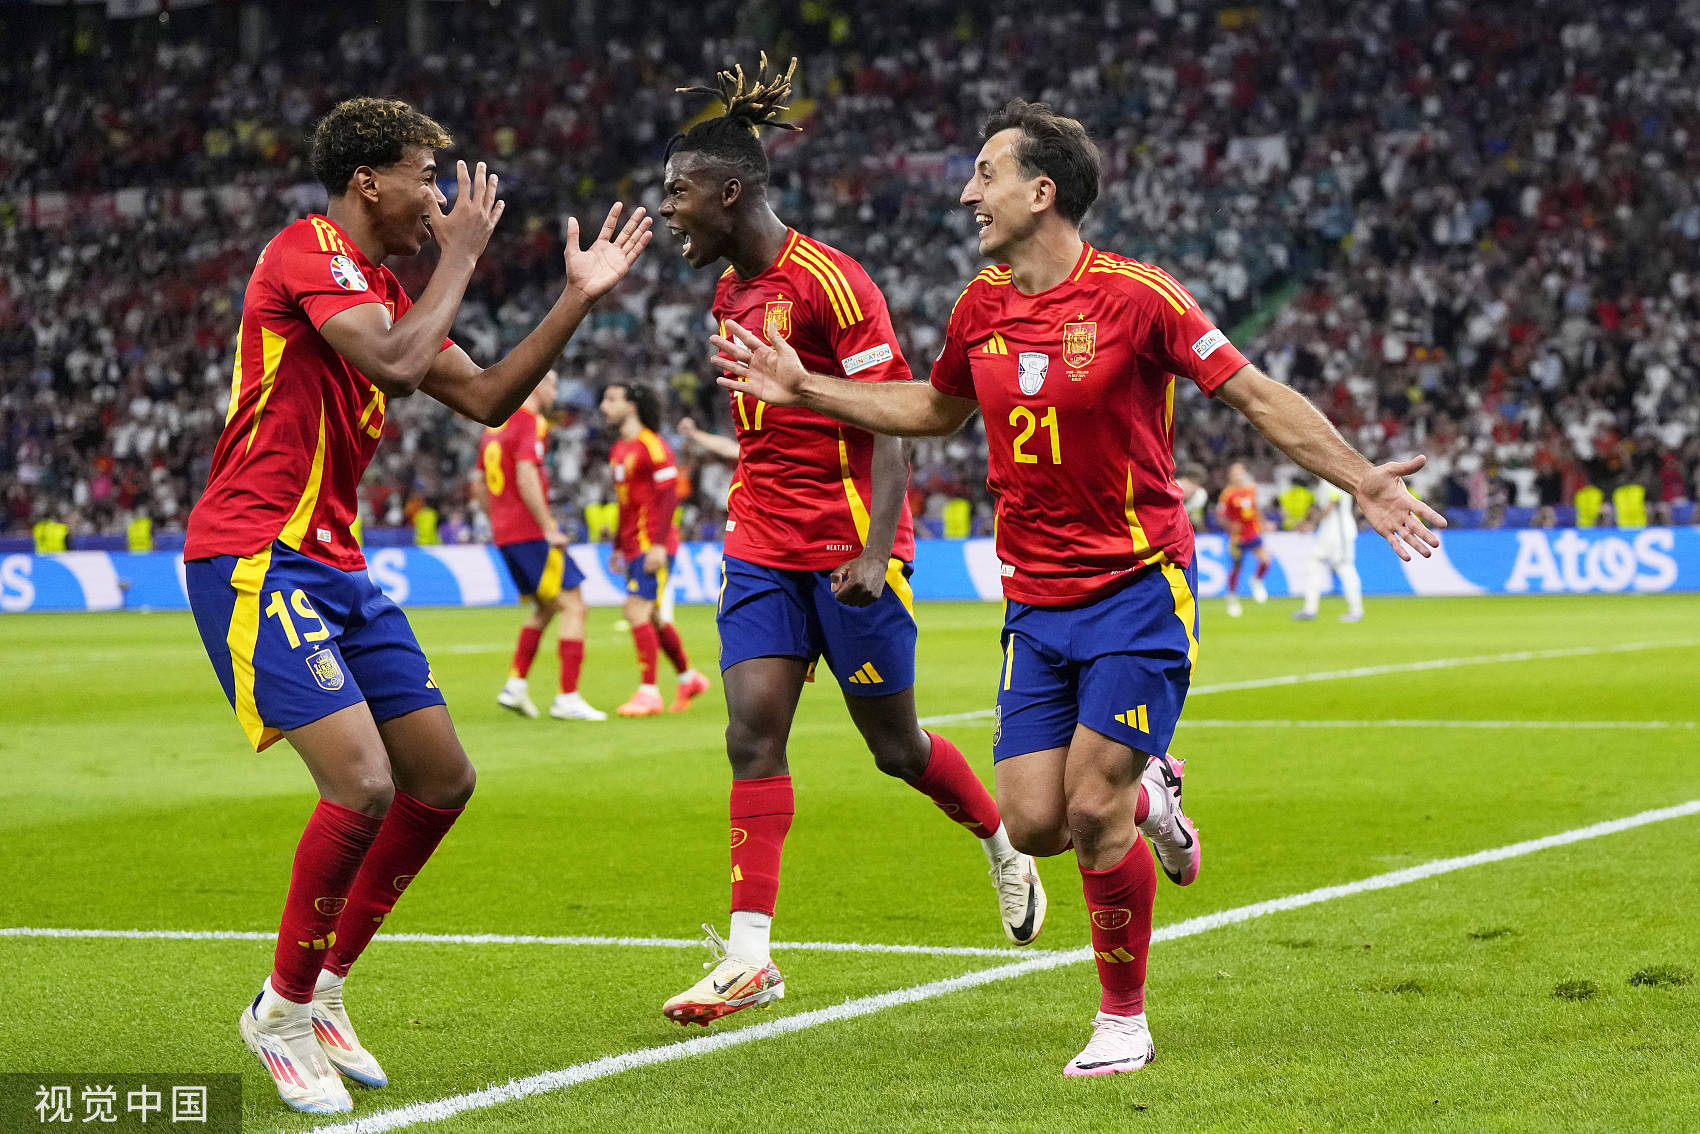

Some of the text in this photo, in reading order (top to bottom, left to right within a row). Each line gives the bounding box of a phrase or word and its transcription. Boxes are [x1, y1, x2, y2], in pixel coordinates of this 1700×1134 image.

[1008, 405, 1062, 465] 21
[483, 440, 506, 497] 8
[265, 588, 330, 650] 19
